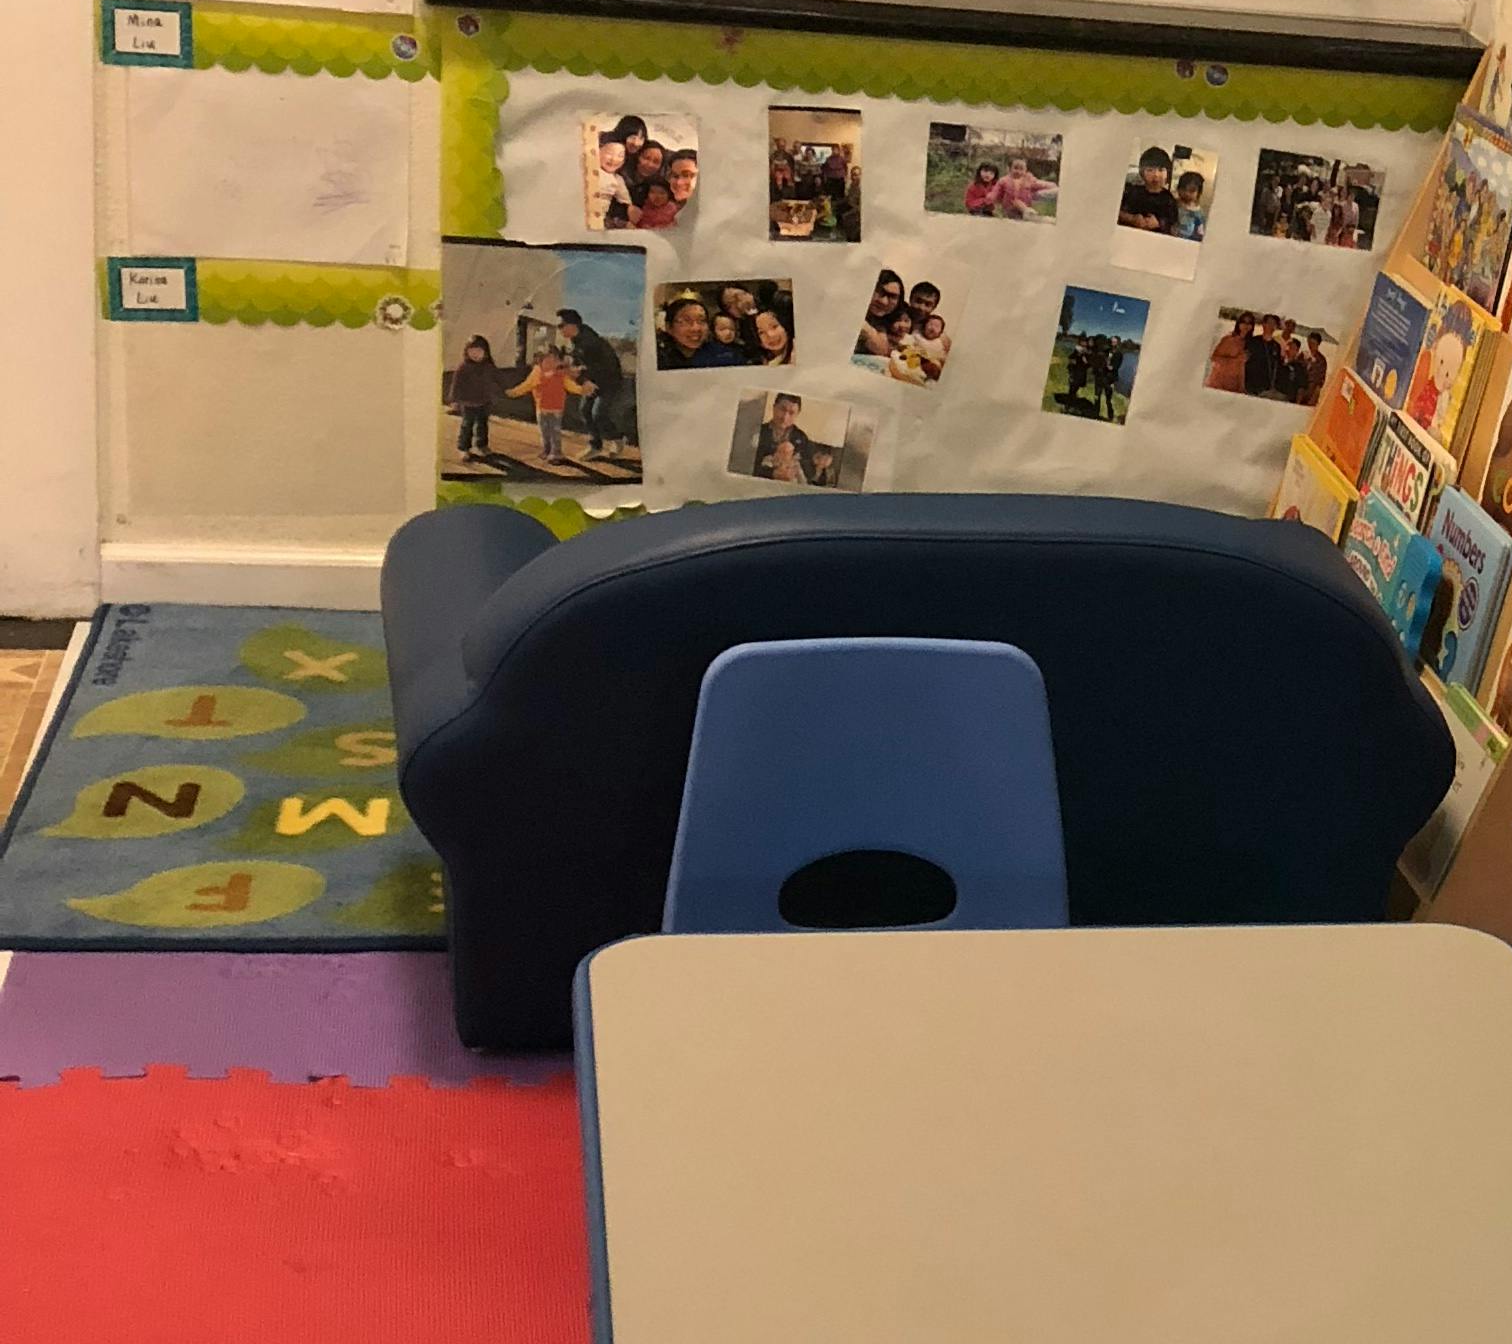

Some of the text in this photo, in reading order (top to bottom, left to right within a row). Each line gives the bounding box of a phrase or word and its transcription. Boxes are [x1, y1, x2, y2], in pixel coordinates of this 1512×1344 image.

[1441, 509, 1487, 575] Numbers
[282, 649, 358, 683] X
[164, 694, 231, 728] T
[185, 872, 254, 913] F
